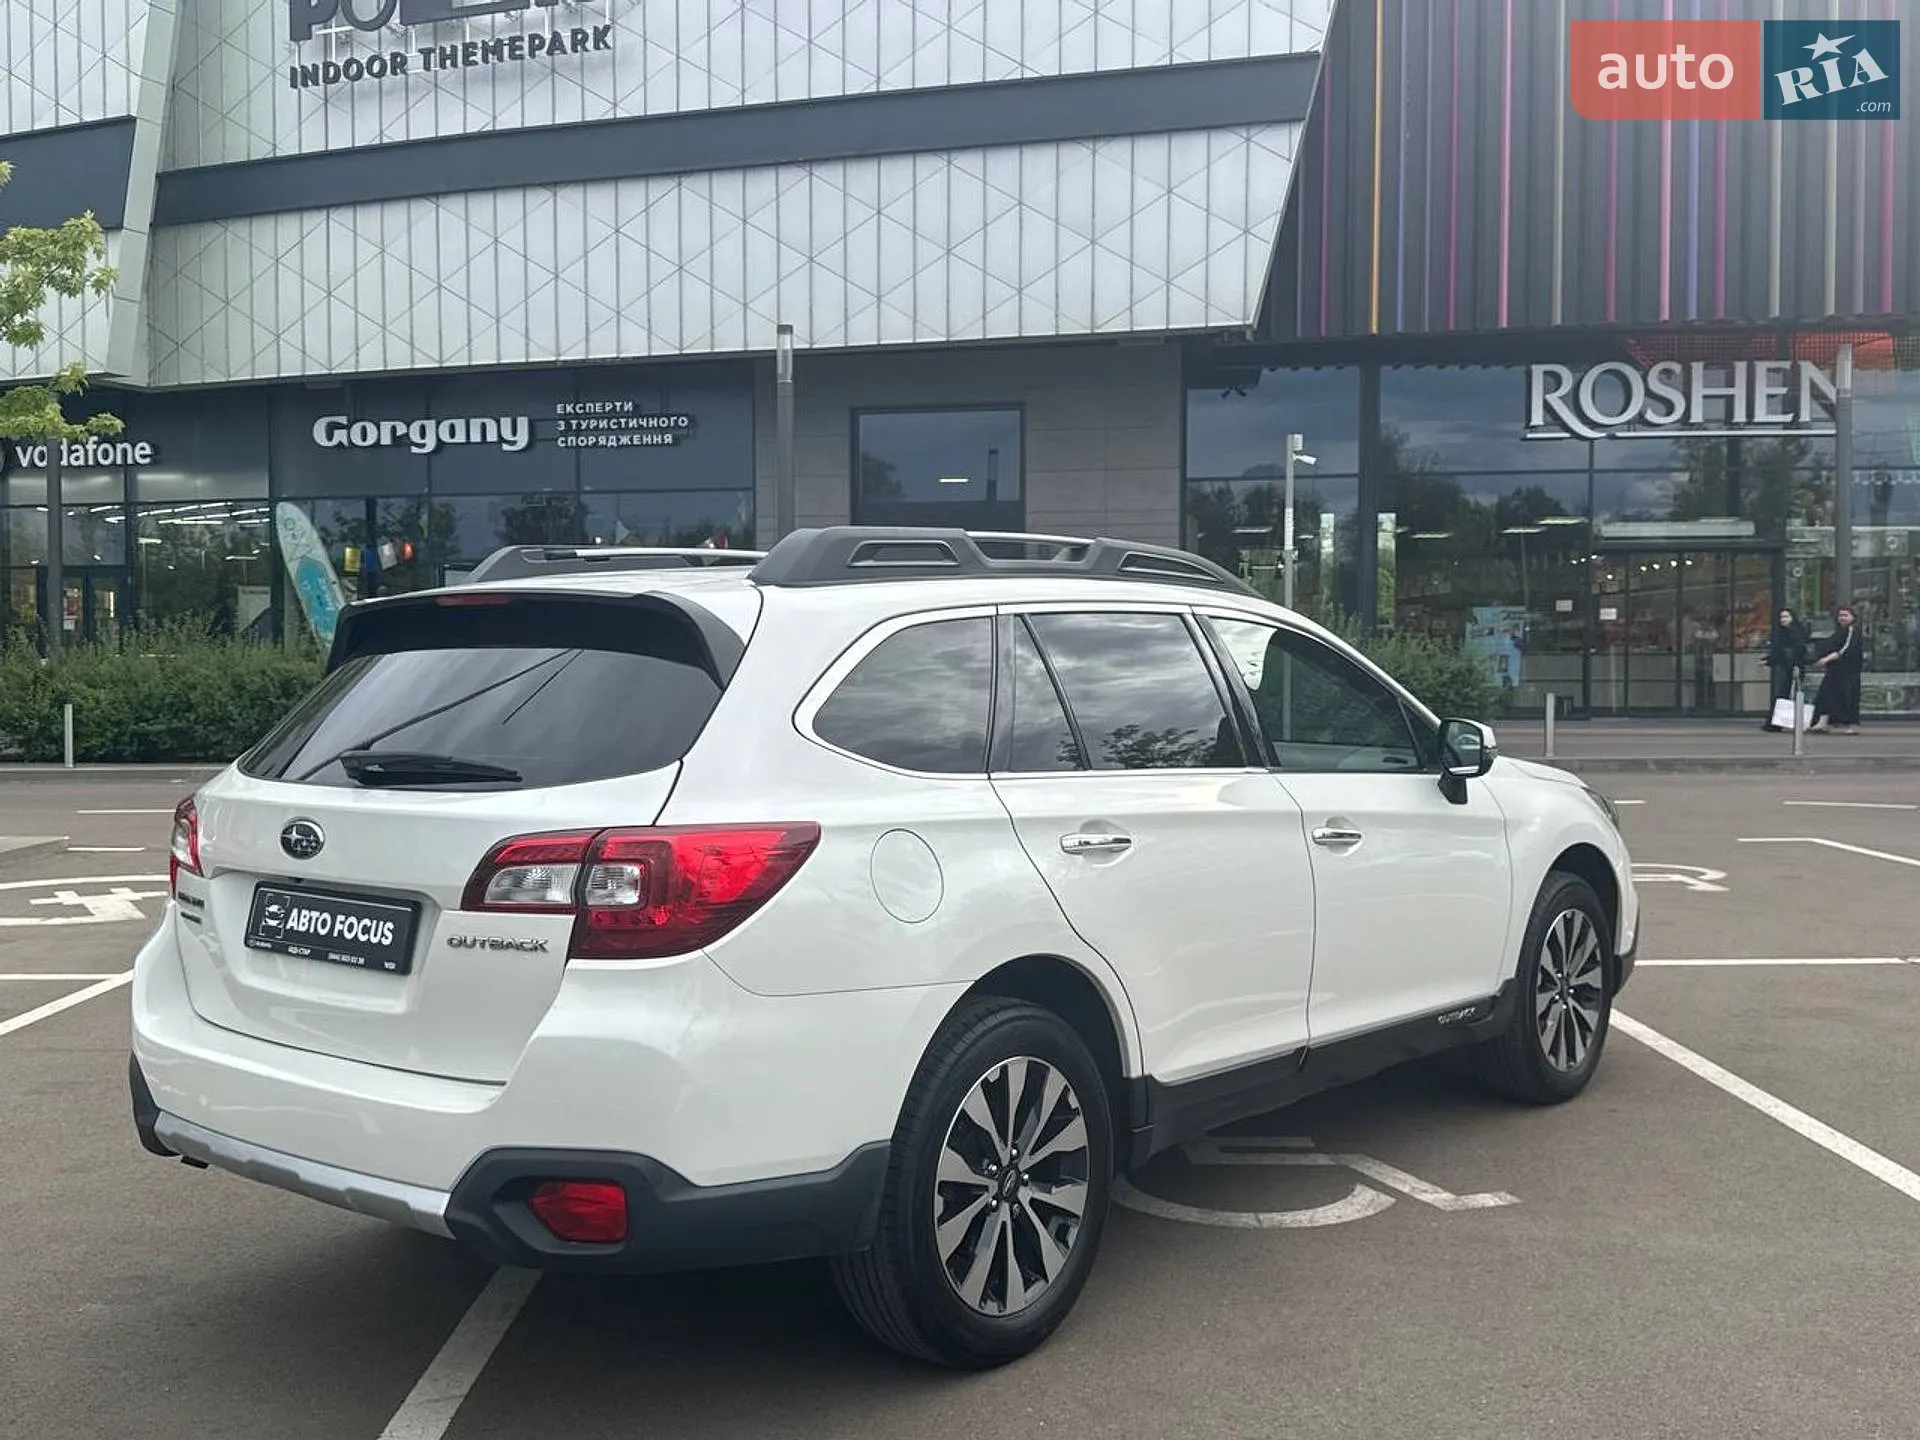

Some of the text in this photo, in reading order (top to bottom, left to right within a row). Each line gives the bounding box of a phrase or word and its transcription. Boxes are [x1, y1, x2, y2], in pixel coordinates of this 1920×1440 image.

[289, 24, 612, 89] INDOOR THEMEPARK
[556, 401, 633, 414] ЕКСПЕРТИ
[1527, 361, 1837, 438] ROSHEN
[313, 415, 529, 454] Gorgany
[570, 416, 689, 430] ТУРИСТИЧНОГО
[557, 433, 673, 447] СПОРЯДЖЕННЯ
[332, 914, 395, 946] FOCUS
[446, 935, 550, 954] OUTBACK
